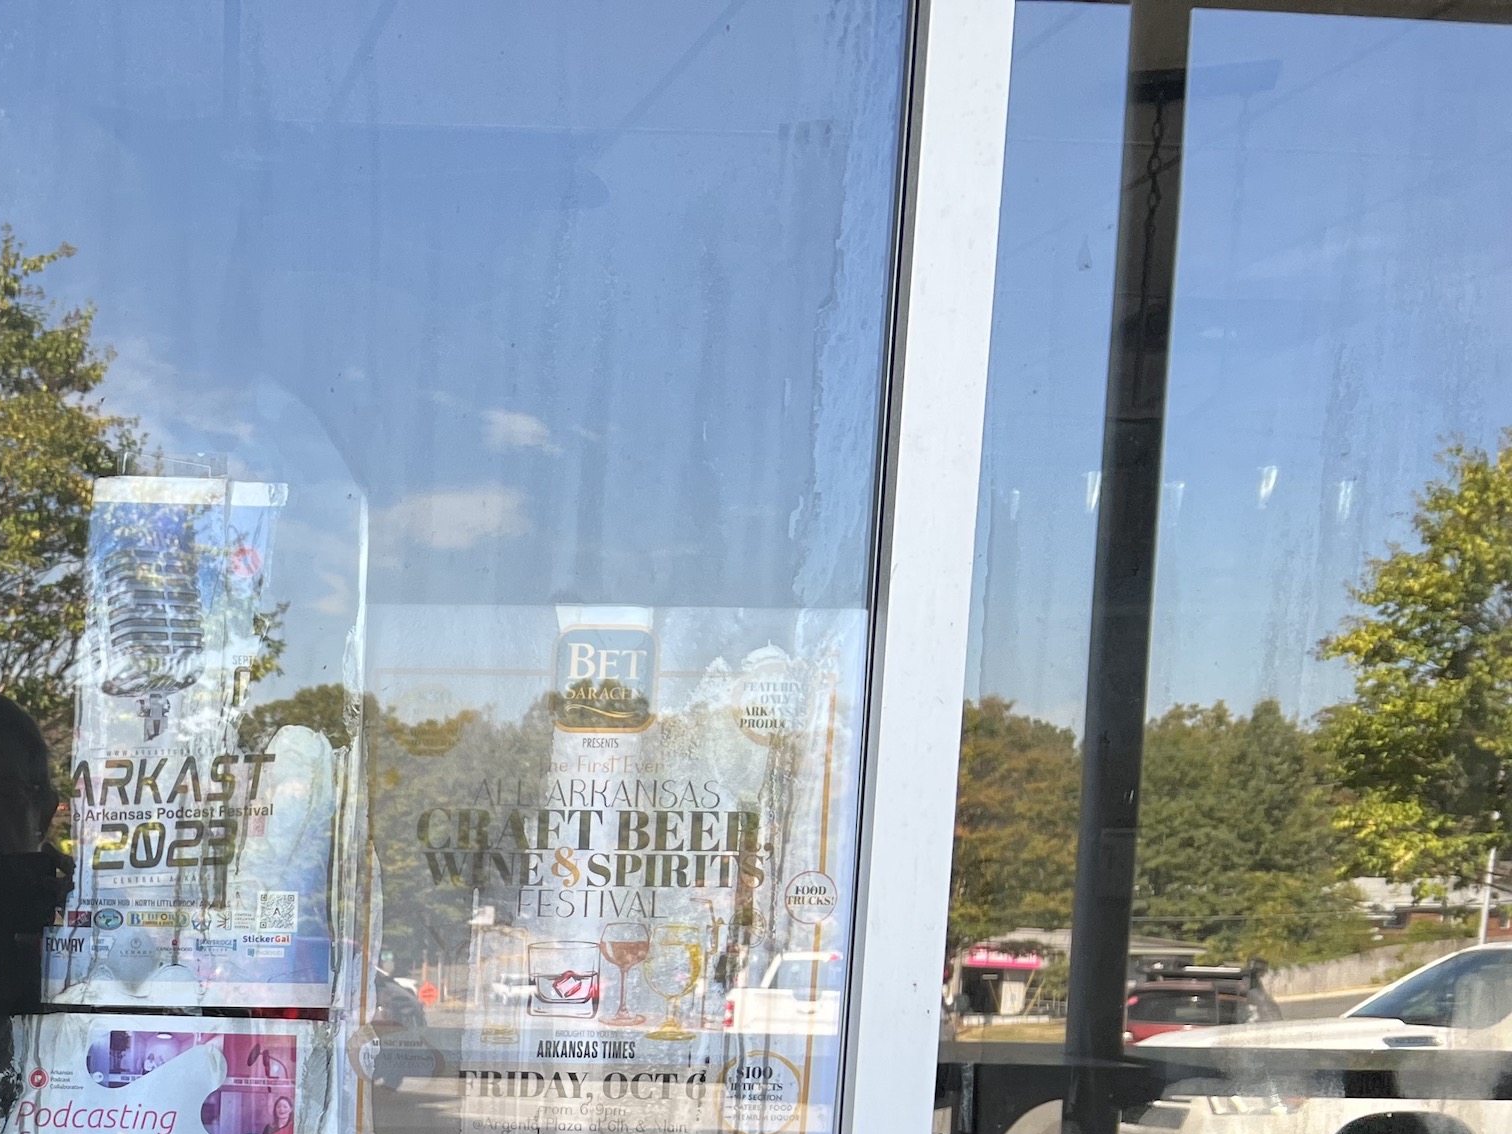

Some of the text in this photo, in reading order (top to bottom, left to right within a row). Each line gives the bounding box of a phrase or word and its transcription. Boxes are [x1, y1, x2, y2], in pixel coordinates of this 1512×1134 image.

[567, 642, 647, 679] BET
[582, 737, 619, 749] PRESENTS
[70, 755, 275, 806] ARKAST
[545, 779, 720, 808] ARKANSAS
[85, 804, 273, 822] Arkansas Podcast Festival
[417, 808, 604, 851] CRAFT
[92, 820, 236, 870] 2023
[422, 847, 766, 888] WINE & SPIRITS
[517, 890, 668, 918] FESTIVAL
[794, 886, 827, 896] FOOD
[46, 938, 85, 952] FLYWAY
[242, 934, 290, 944] StickerGal
[536, 1040, 635, 1059] ARKANSAS TIMES
[459, 1069, 677, 1103] FRIDAY, OCT
